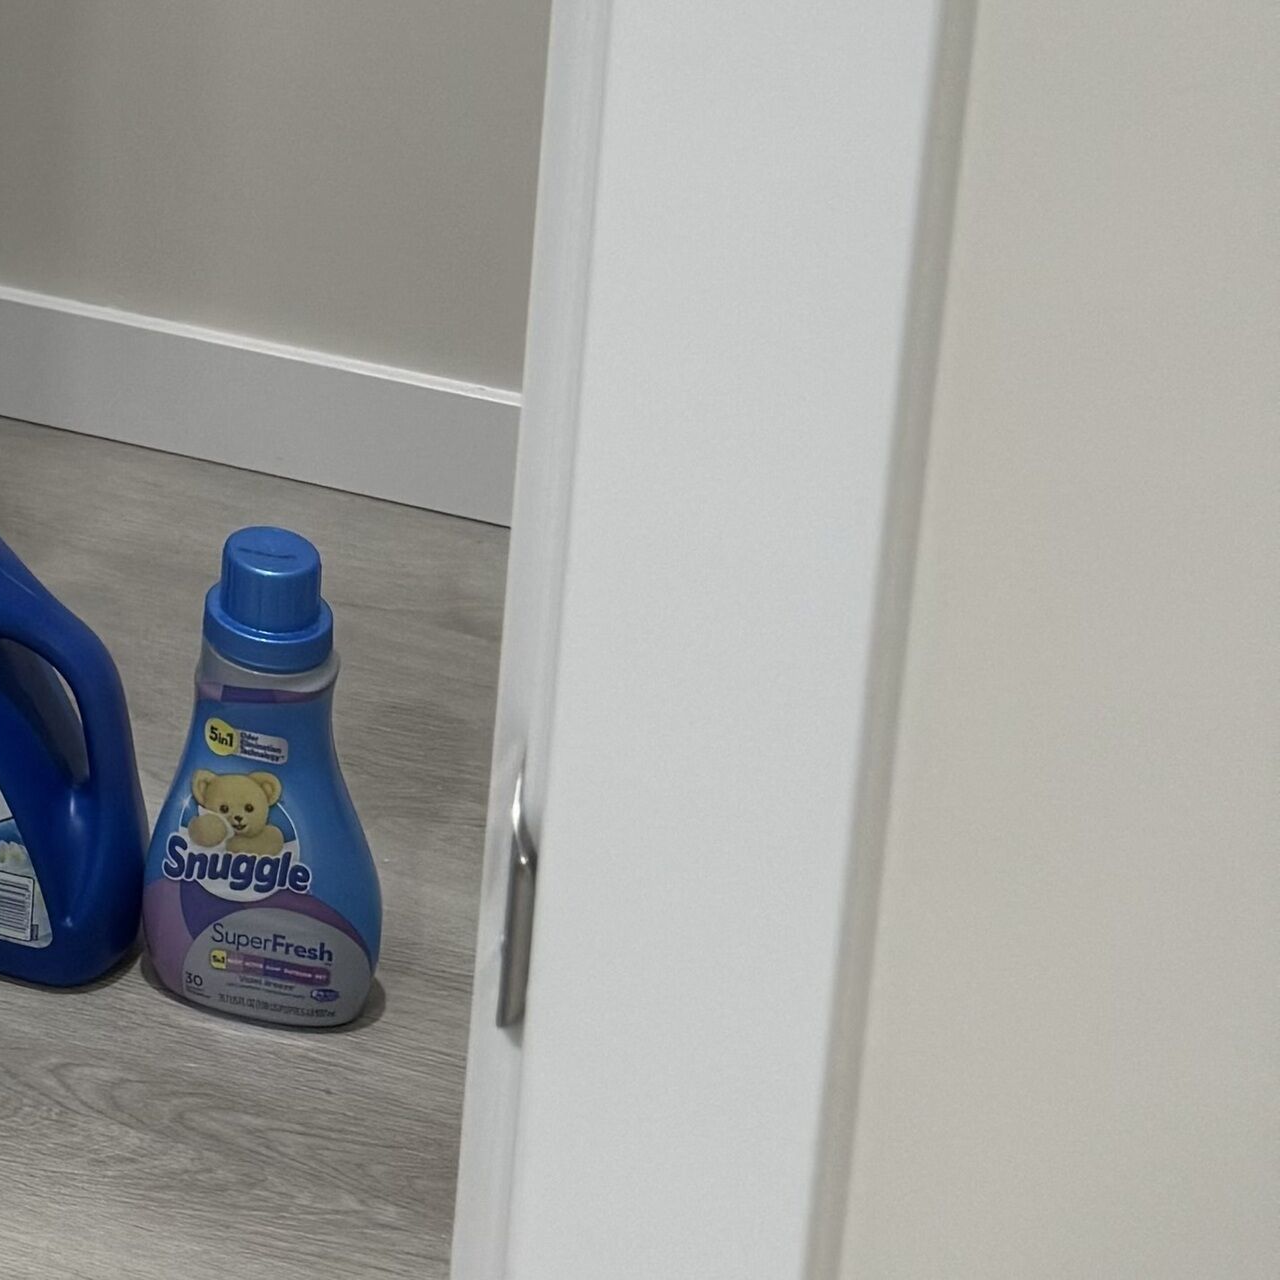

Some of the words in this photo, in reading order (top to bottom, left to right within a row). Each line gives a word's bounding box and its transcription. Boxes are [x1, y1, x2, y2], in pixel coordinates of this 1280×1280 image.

[208, 725, 234, 748] 5in1
[163, 834, 310, 893] Snuggle
[211, 922, 333, 962] SuperFresh
[185, 971, 203, 987] 30
